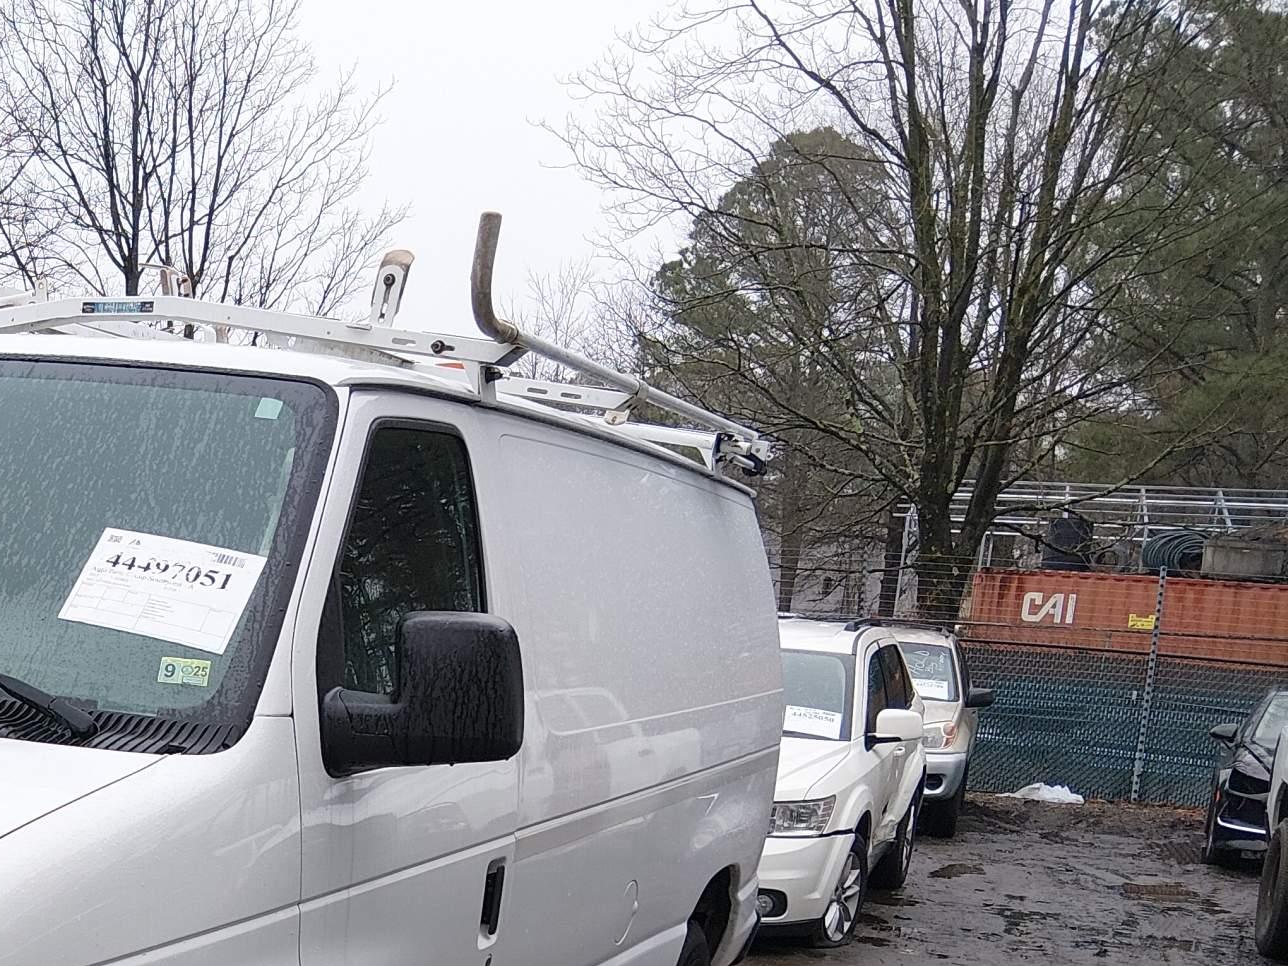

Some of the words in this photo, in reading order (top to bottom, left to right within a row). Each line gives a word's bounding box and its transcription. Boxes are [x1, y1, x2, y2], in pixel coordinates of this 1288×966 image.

[106, 551, 233, 590] 44497051
[1021, 591, 1077, 624] CAI
[164, 663, 177, 678] 9
[193, 665, 209, 678] 25
